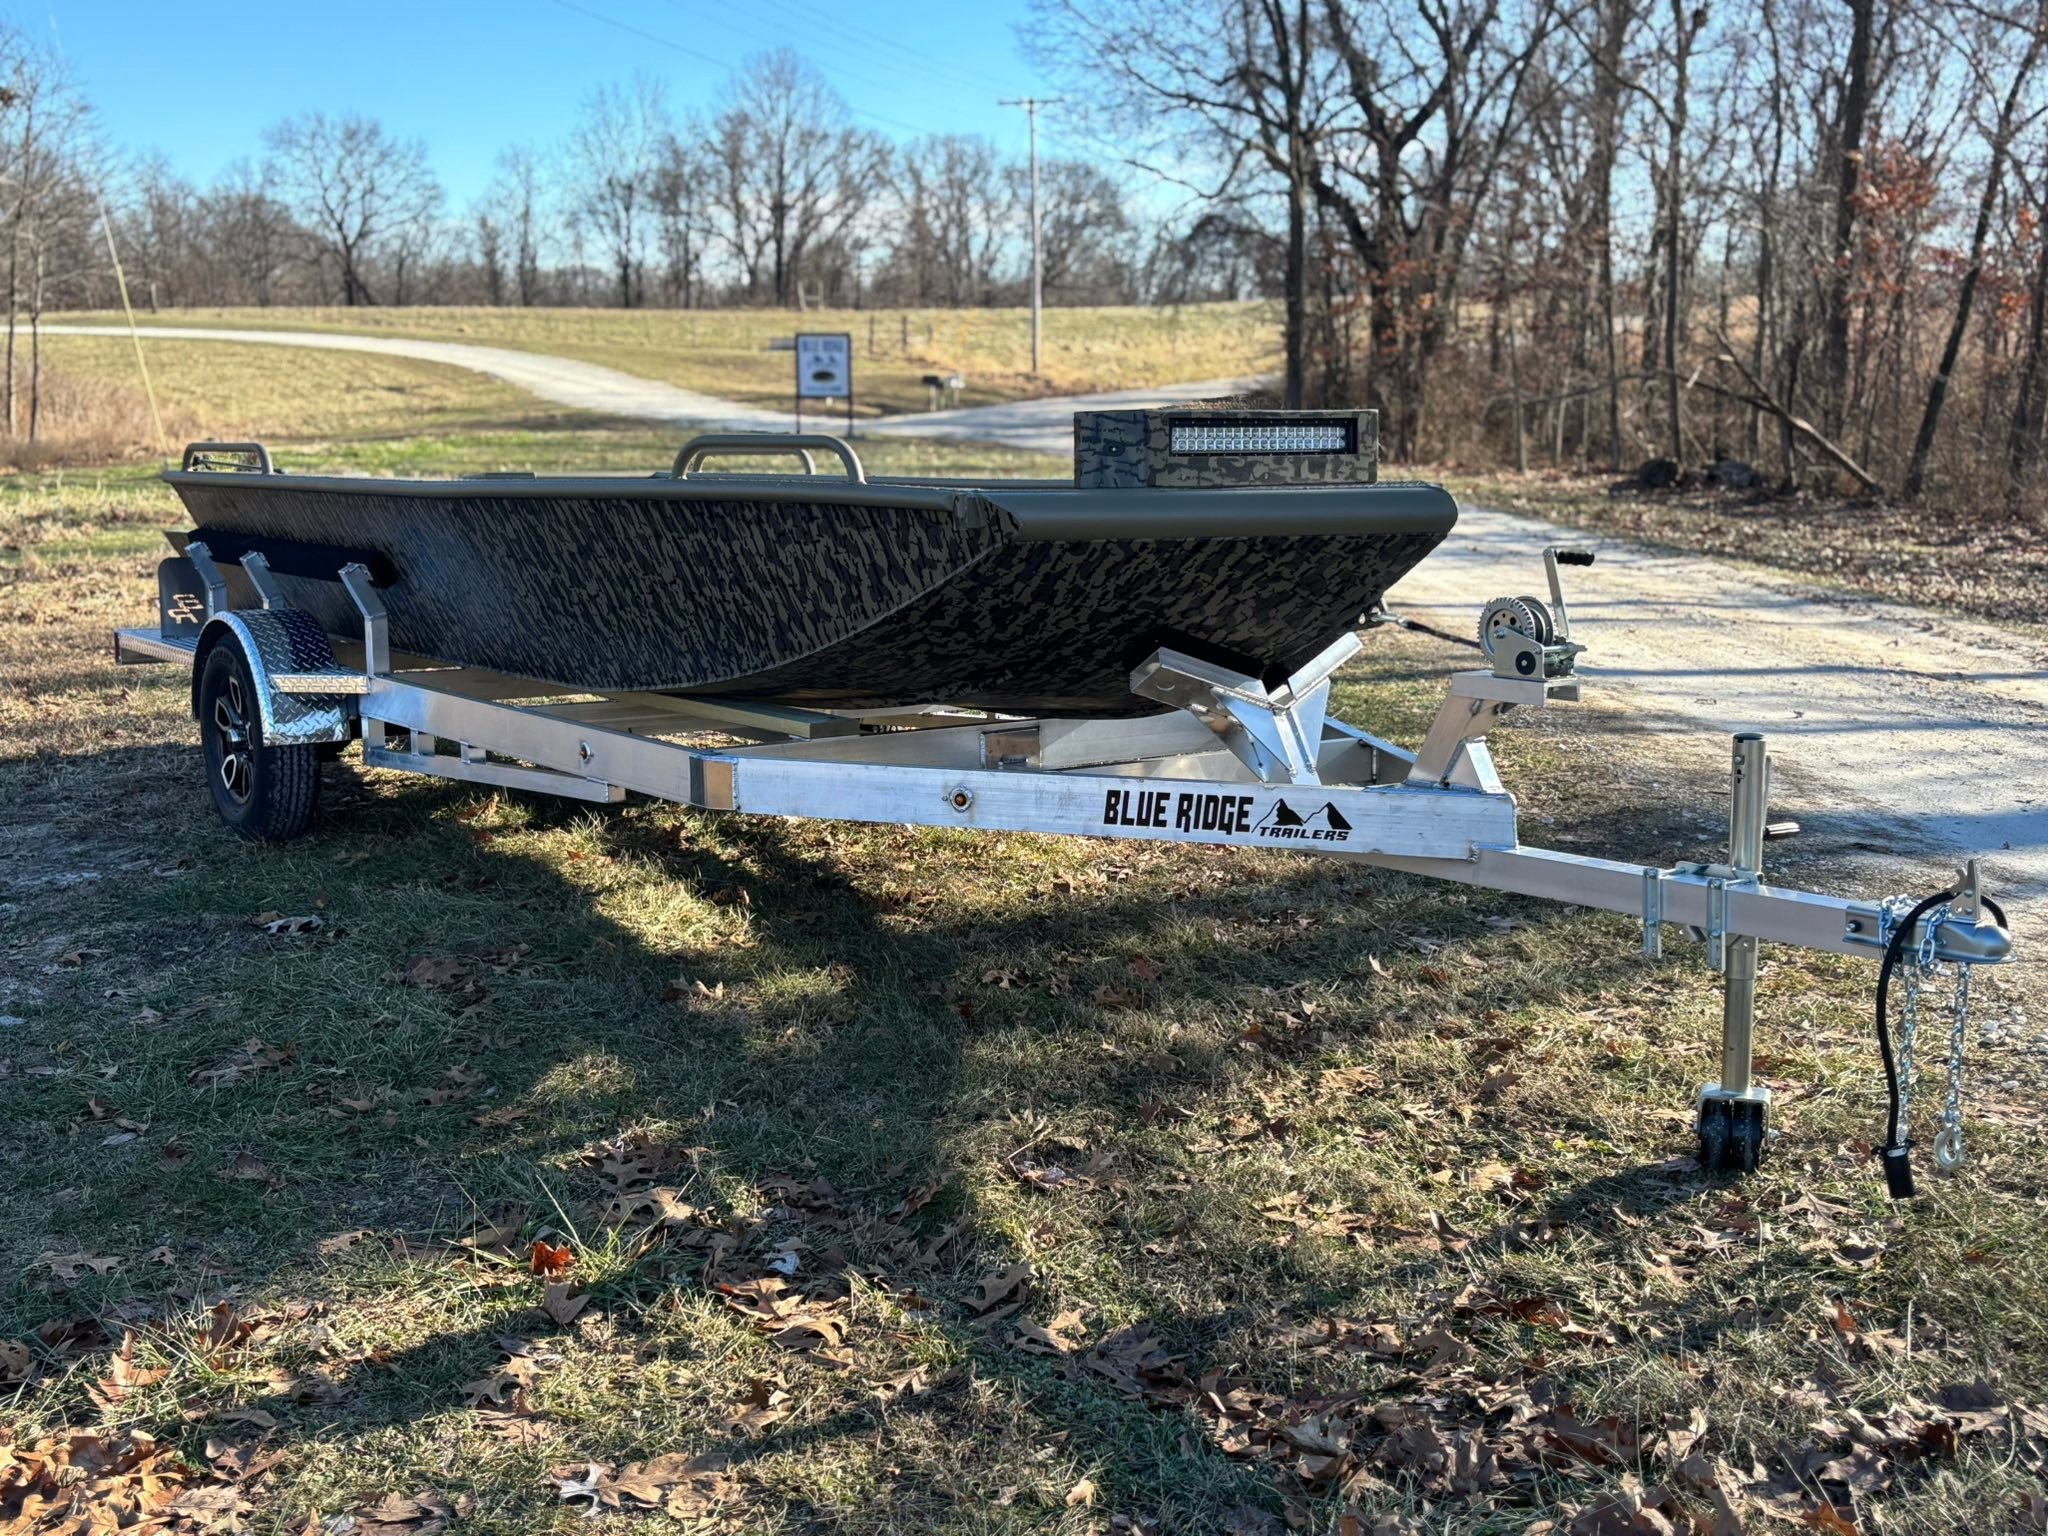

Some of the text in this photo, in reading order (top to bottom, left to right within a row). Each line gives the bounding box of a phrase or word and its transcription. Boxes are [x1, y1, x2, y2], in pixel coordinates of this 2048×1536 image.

[1103, 789, 1254, 835] BLUE RIDGE
[1259, 826, 1350, 841] TRAILERS
